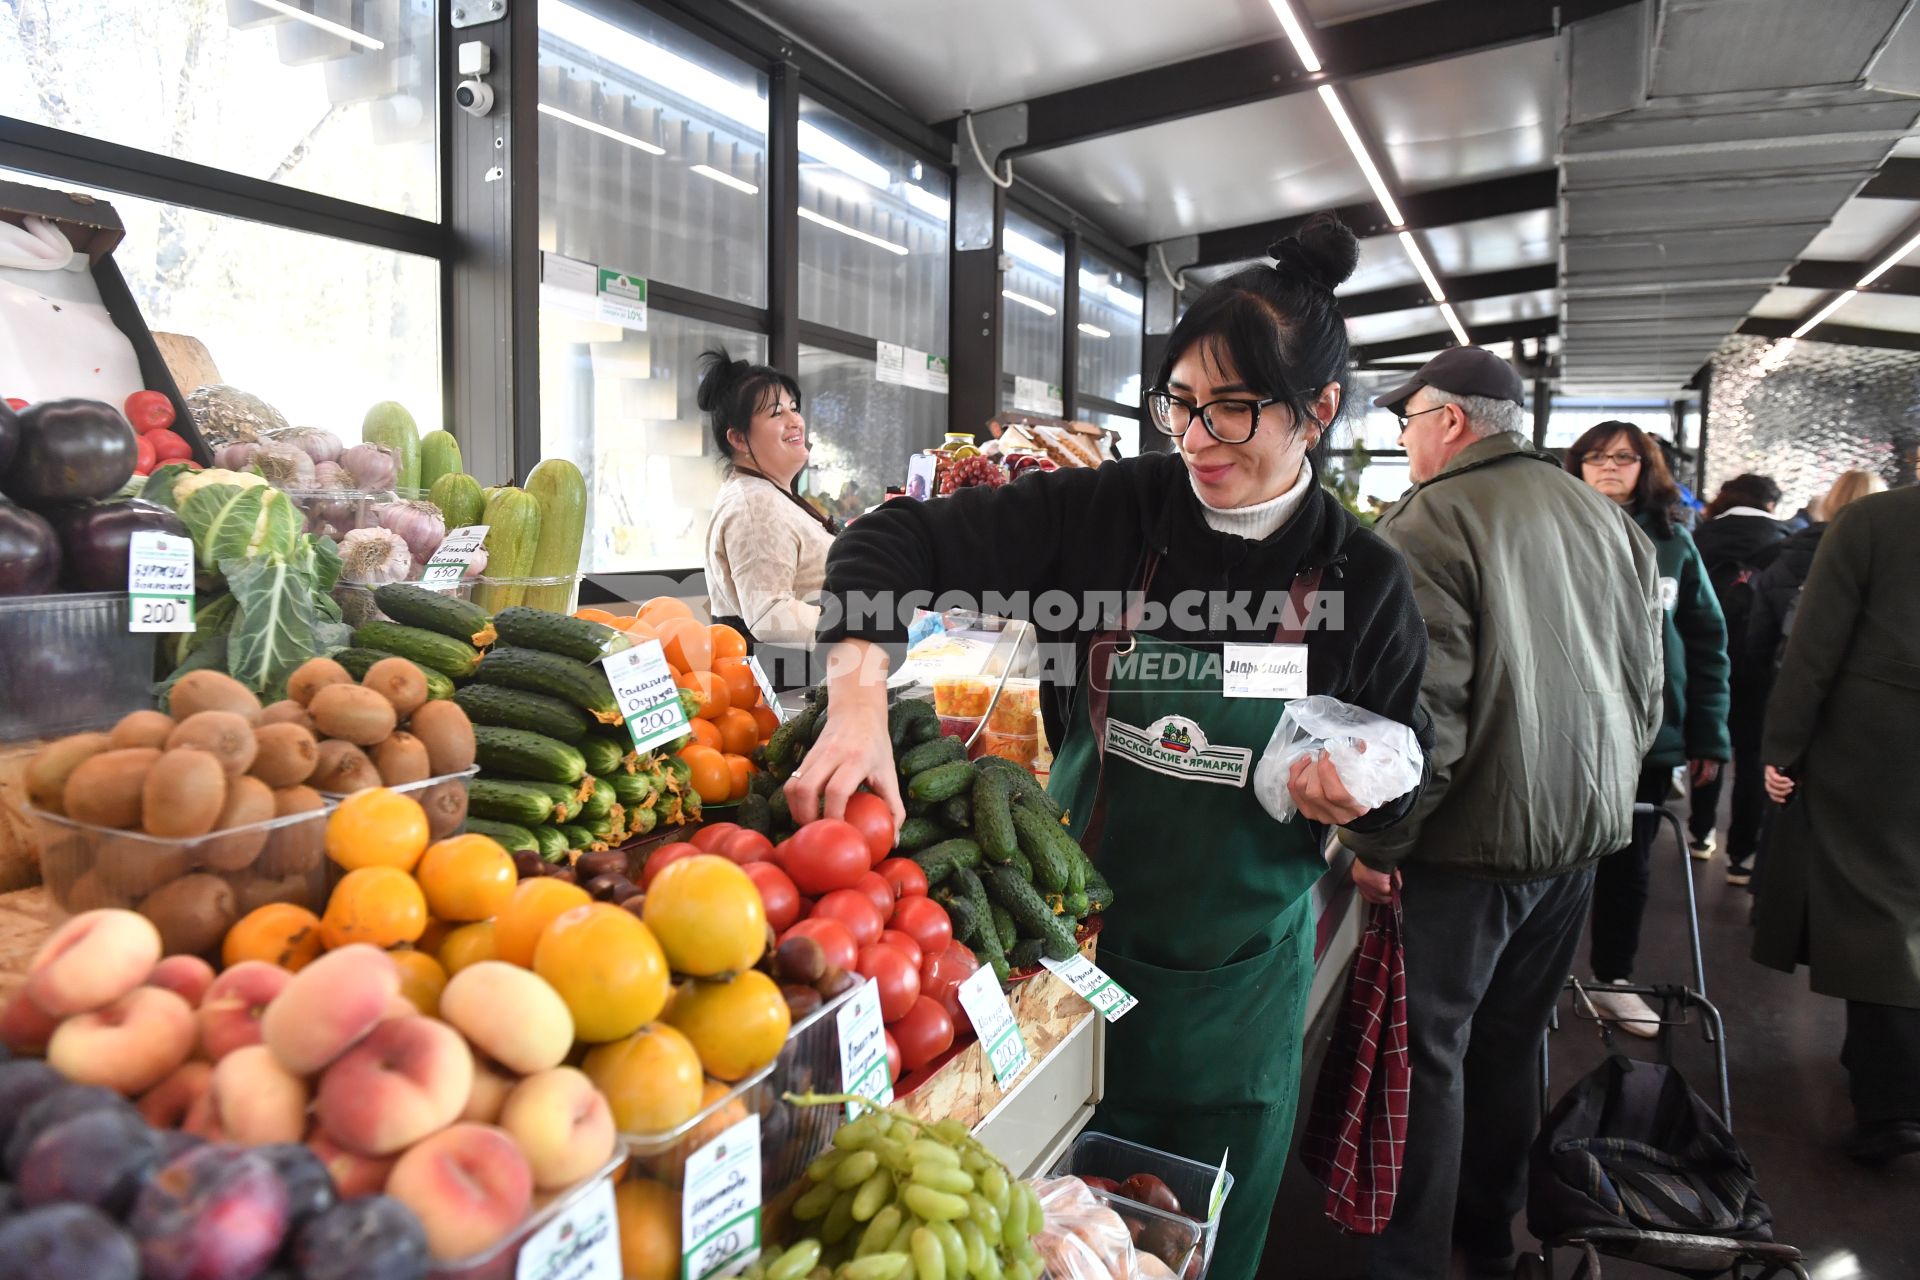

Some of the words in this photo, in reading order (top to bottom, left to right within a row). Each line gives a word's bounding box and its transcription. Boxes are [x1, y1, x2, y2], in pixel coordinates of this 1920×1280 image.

[142, 603, 175, 623] 200
[640, 709, 674, 734] 200
[1109, 733, 1181, 764] МОСКОВСКИЕ
[1189, 759, 1243, 773] ЯРМАРКИ
[996, 1038, 1017, 1068] 200
